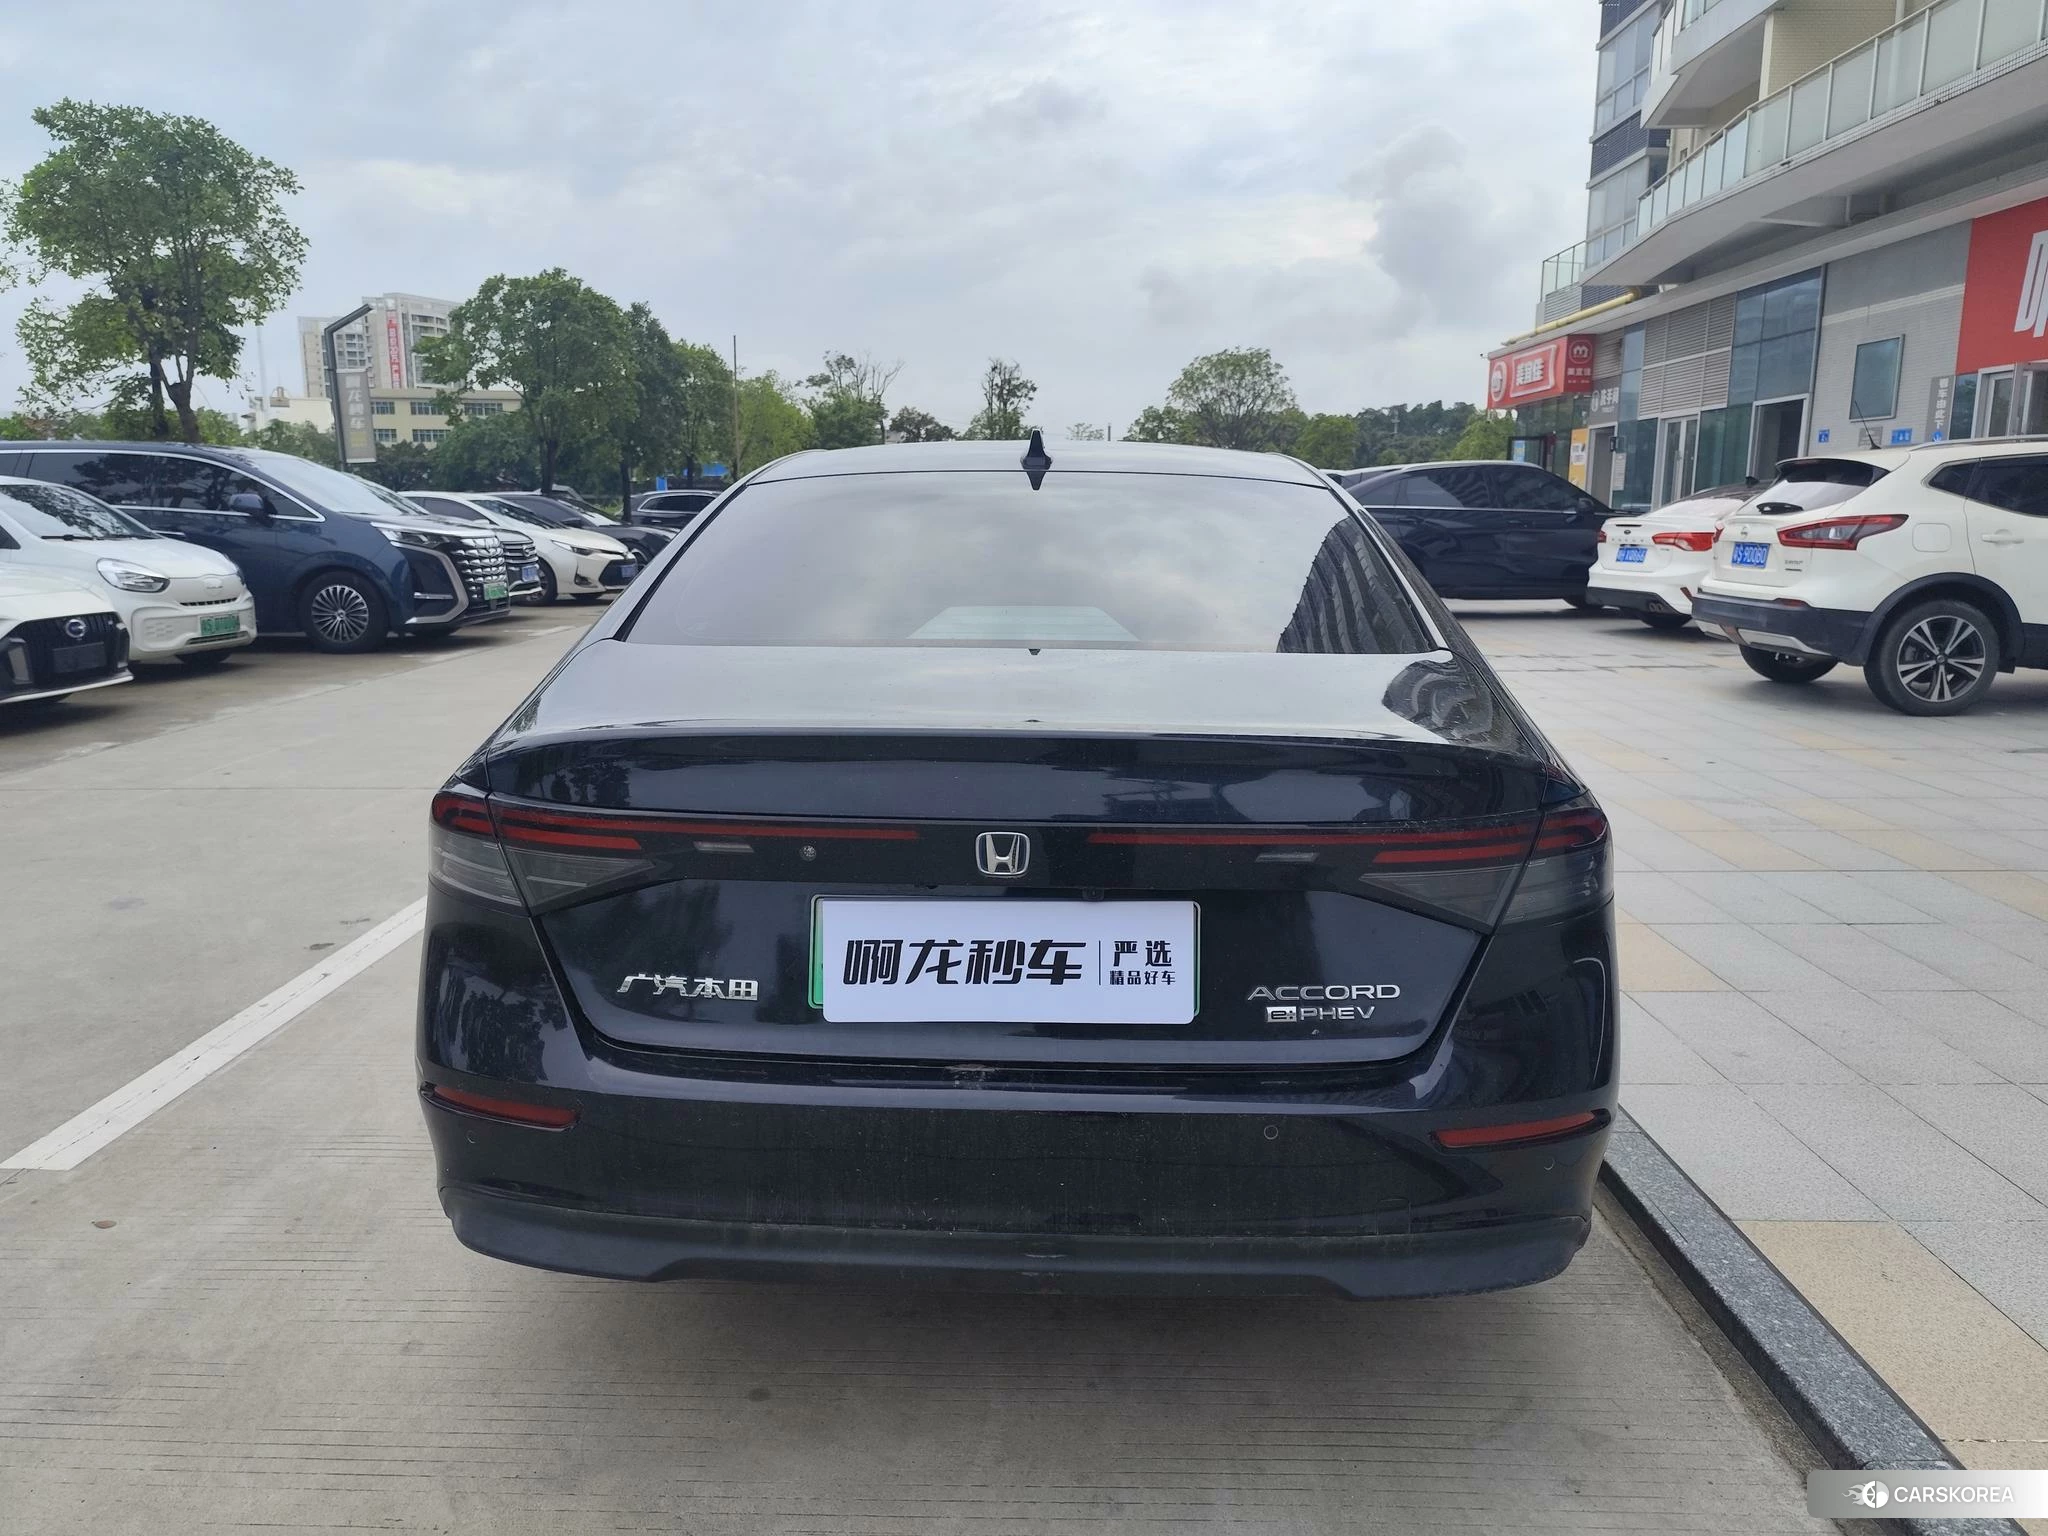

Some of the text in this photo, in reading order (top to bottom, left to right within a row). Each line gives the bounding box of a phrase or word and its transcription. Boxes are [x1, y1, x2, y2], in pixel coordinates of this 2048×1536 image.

[843, 939, 1086, 985] 啊龙秒车
[1113, 940, 1172, 966] 严选
[617, 973, 759, 1000] 广汽本田
[1109, 970, 1176, 985] 精品好车
[1247, 984, 1401, 1000] ACCORD
